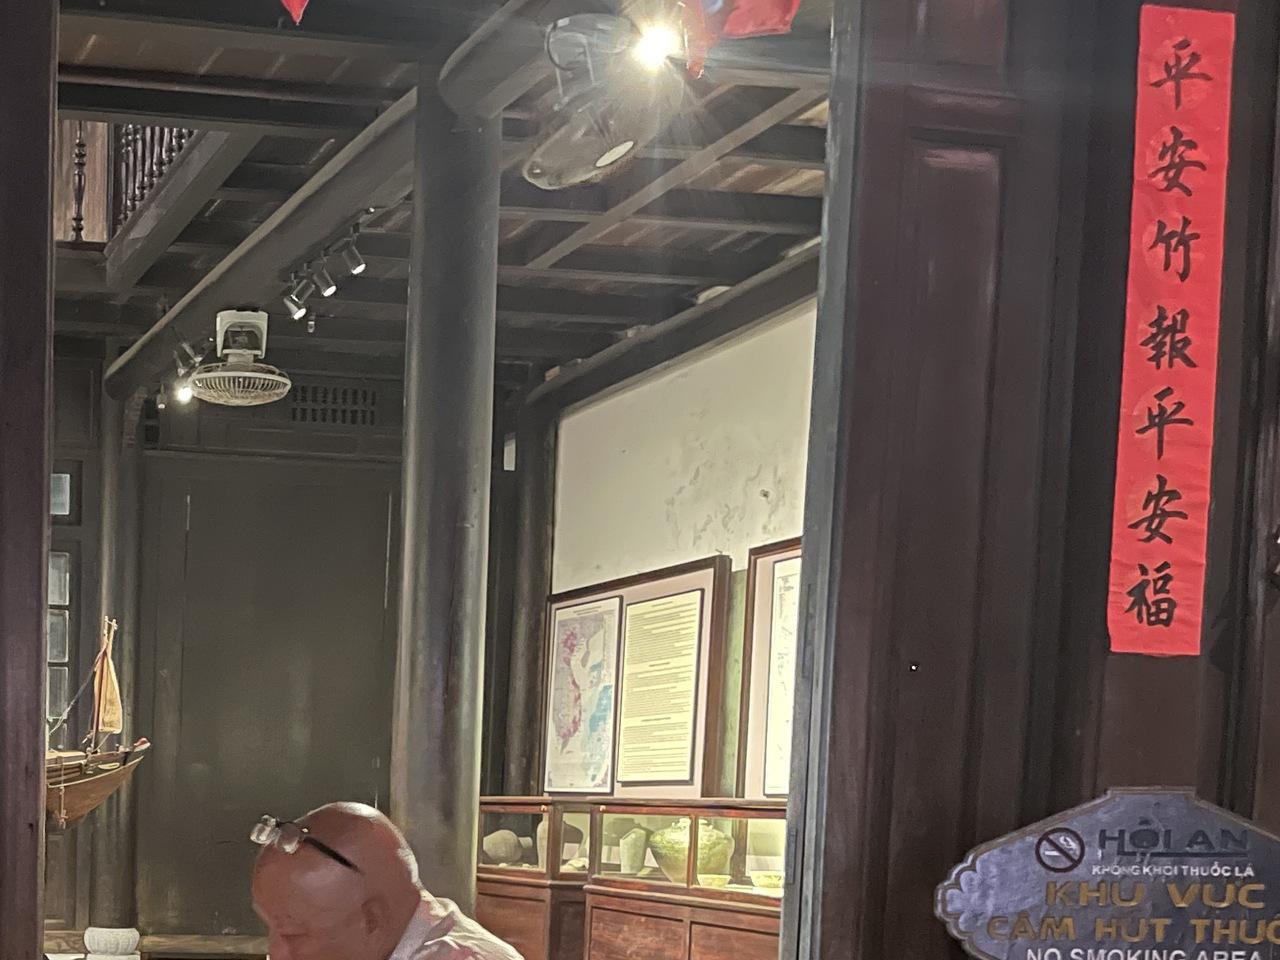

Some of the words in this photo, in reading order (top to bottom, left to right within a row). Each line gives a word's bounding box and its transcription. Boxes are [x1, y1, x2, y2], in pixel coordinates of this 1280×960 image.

[1124, 38, 1214, 629] 平安竹報平安福
